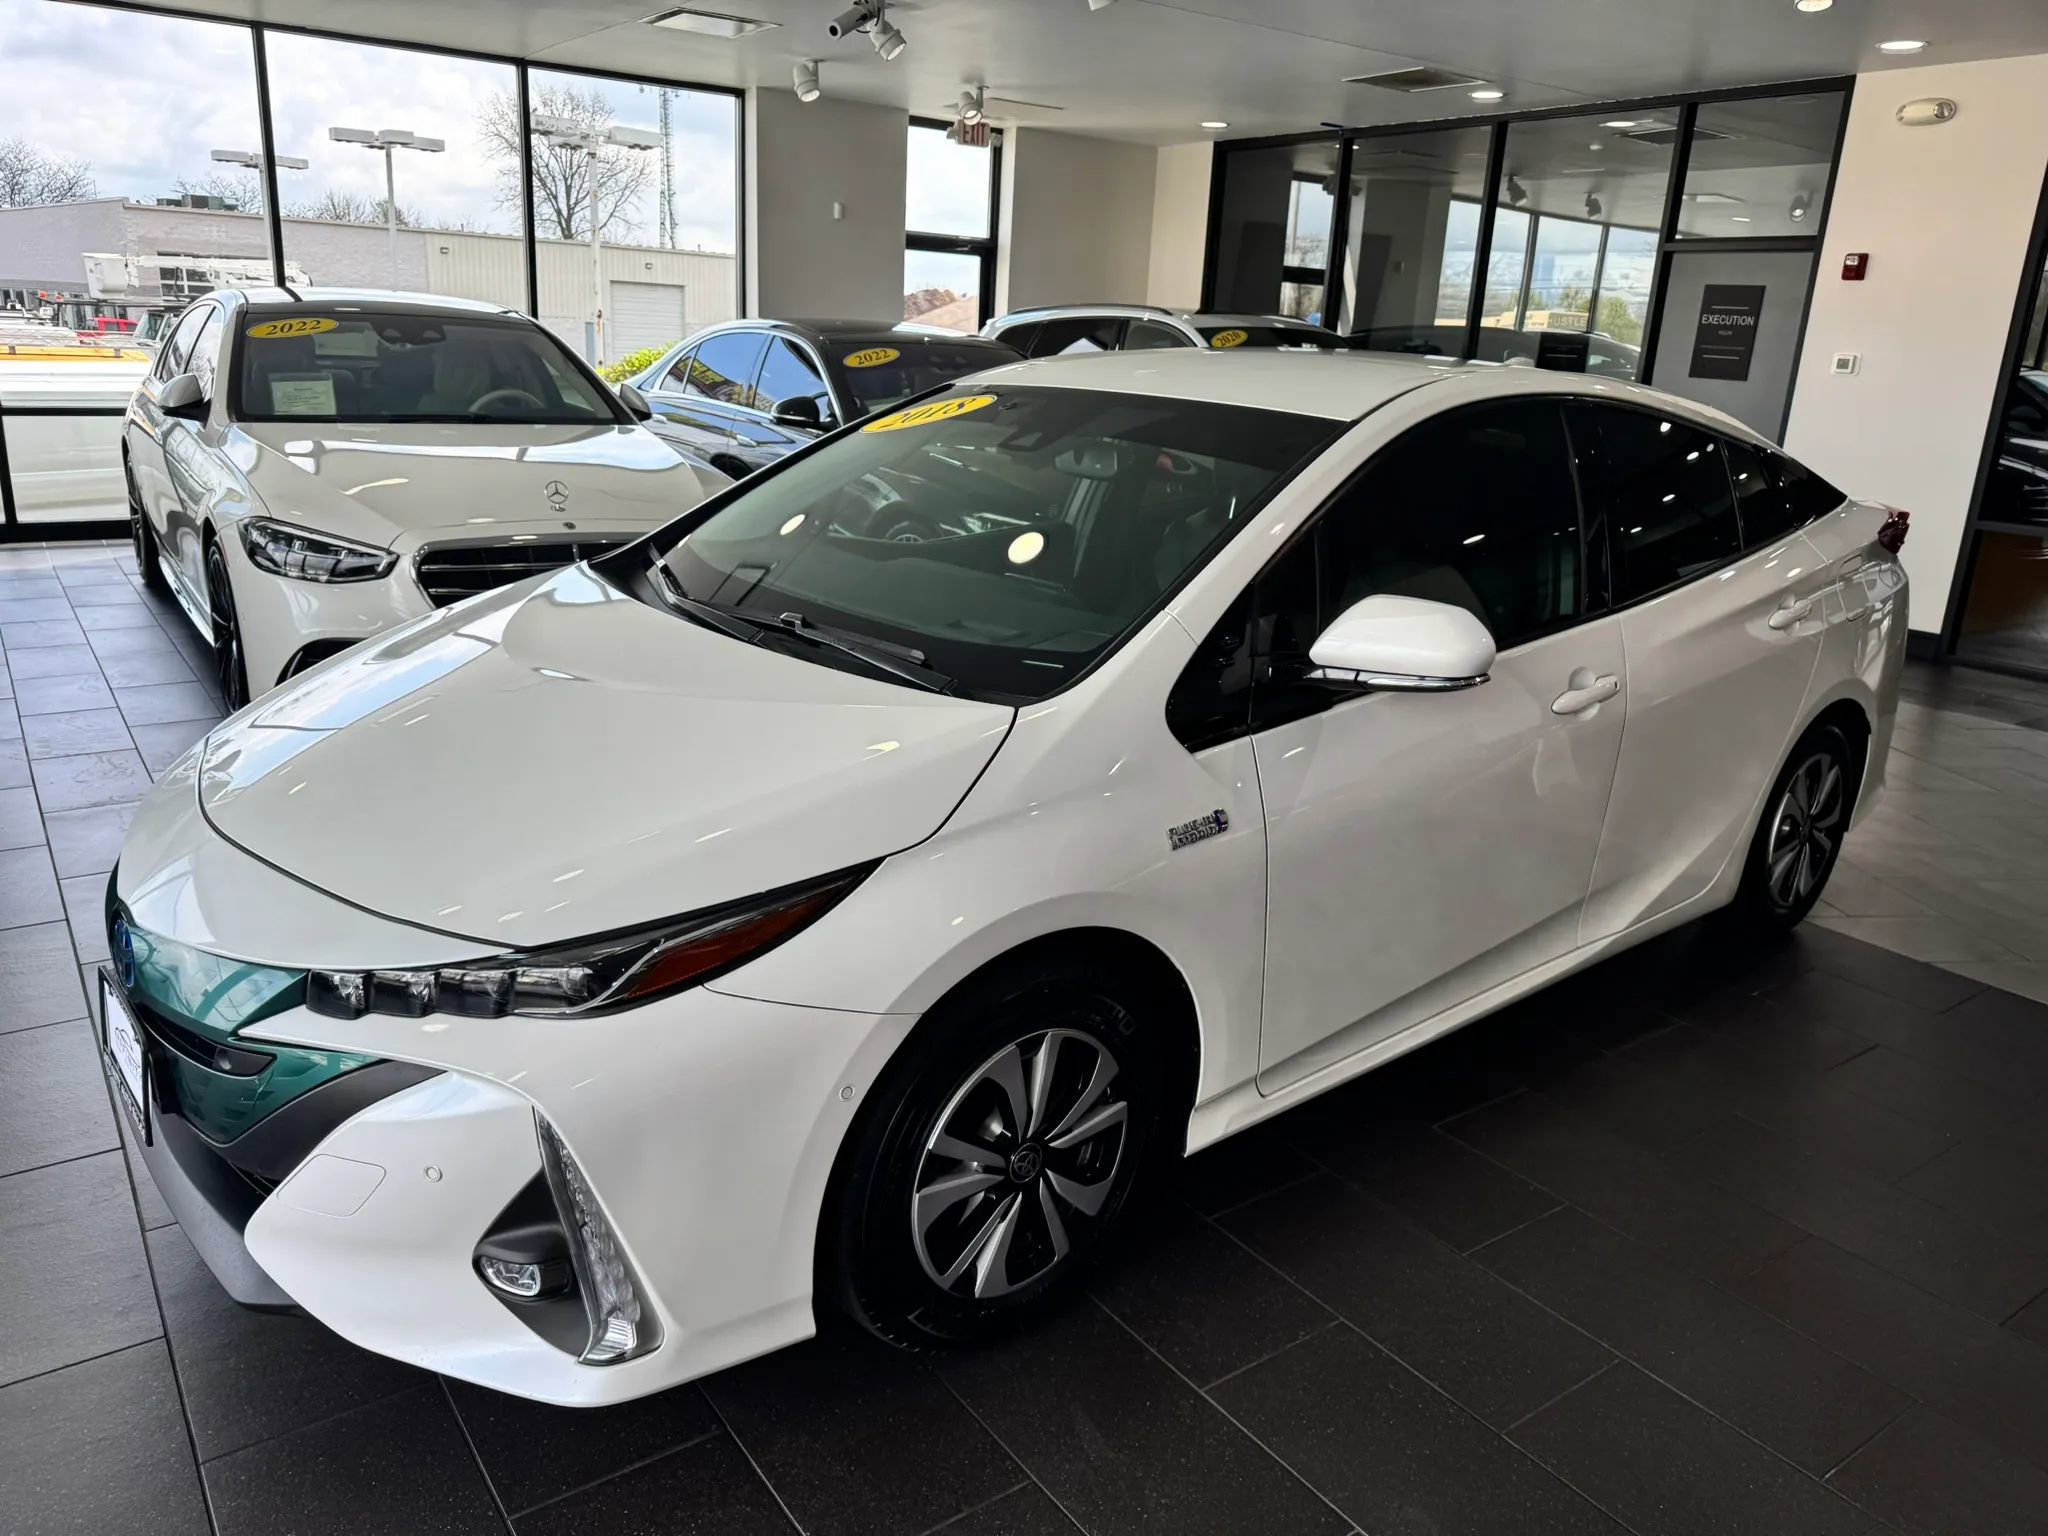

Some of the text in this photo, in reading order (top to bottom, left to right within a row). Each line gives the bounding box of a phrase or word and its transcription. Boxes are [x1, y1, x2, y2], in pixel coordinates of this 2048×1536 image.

[265, 319, 321, 336] 2022
[1701, 314, 1755, 326] EXECUTION
[1216, 331, 1242, 347] 2020
[854, 349, 890, 365] 2022
[877, 398, 977, 430] 2018
